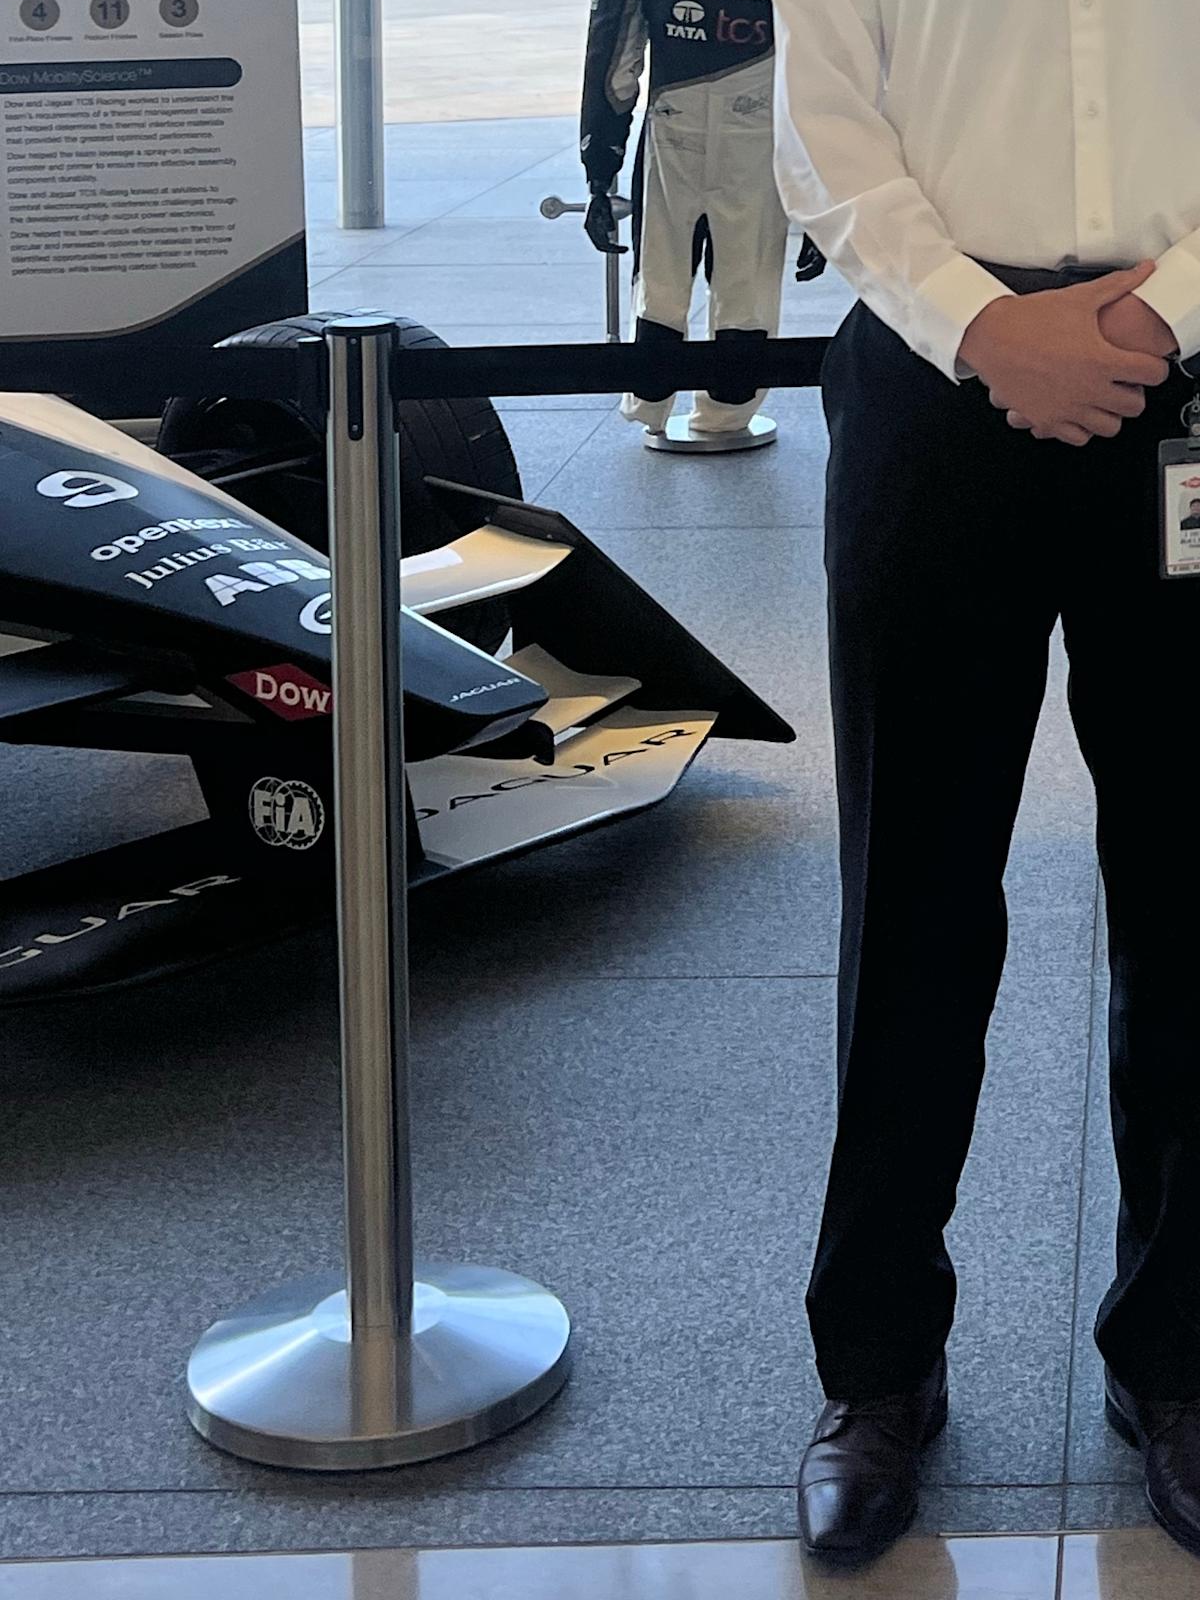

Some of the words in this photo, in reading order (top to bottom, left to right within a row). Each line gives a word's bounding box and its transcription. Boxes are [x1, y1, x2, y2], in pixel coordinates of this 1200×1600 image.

[32, 2, 47, 22] 4
[97, 0, 122, 21] 11
[716, 8, 768, 44] tcs
[665, 23, 708, 42] TATA
[90, 518, 254, 562] opentext
[124, 542, 233, 590] Julius
[228, 538, 292, 552] Bär
[204, 559, 332, 608] ABB
[448, 677, 520, 702] JAGUAR
[0, 874, 242, 968] GUAR
